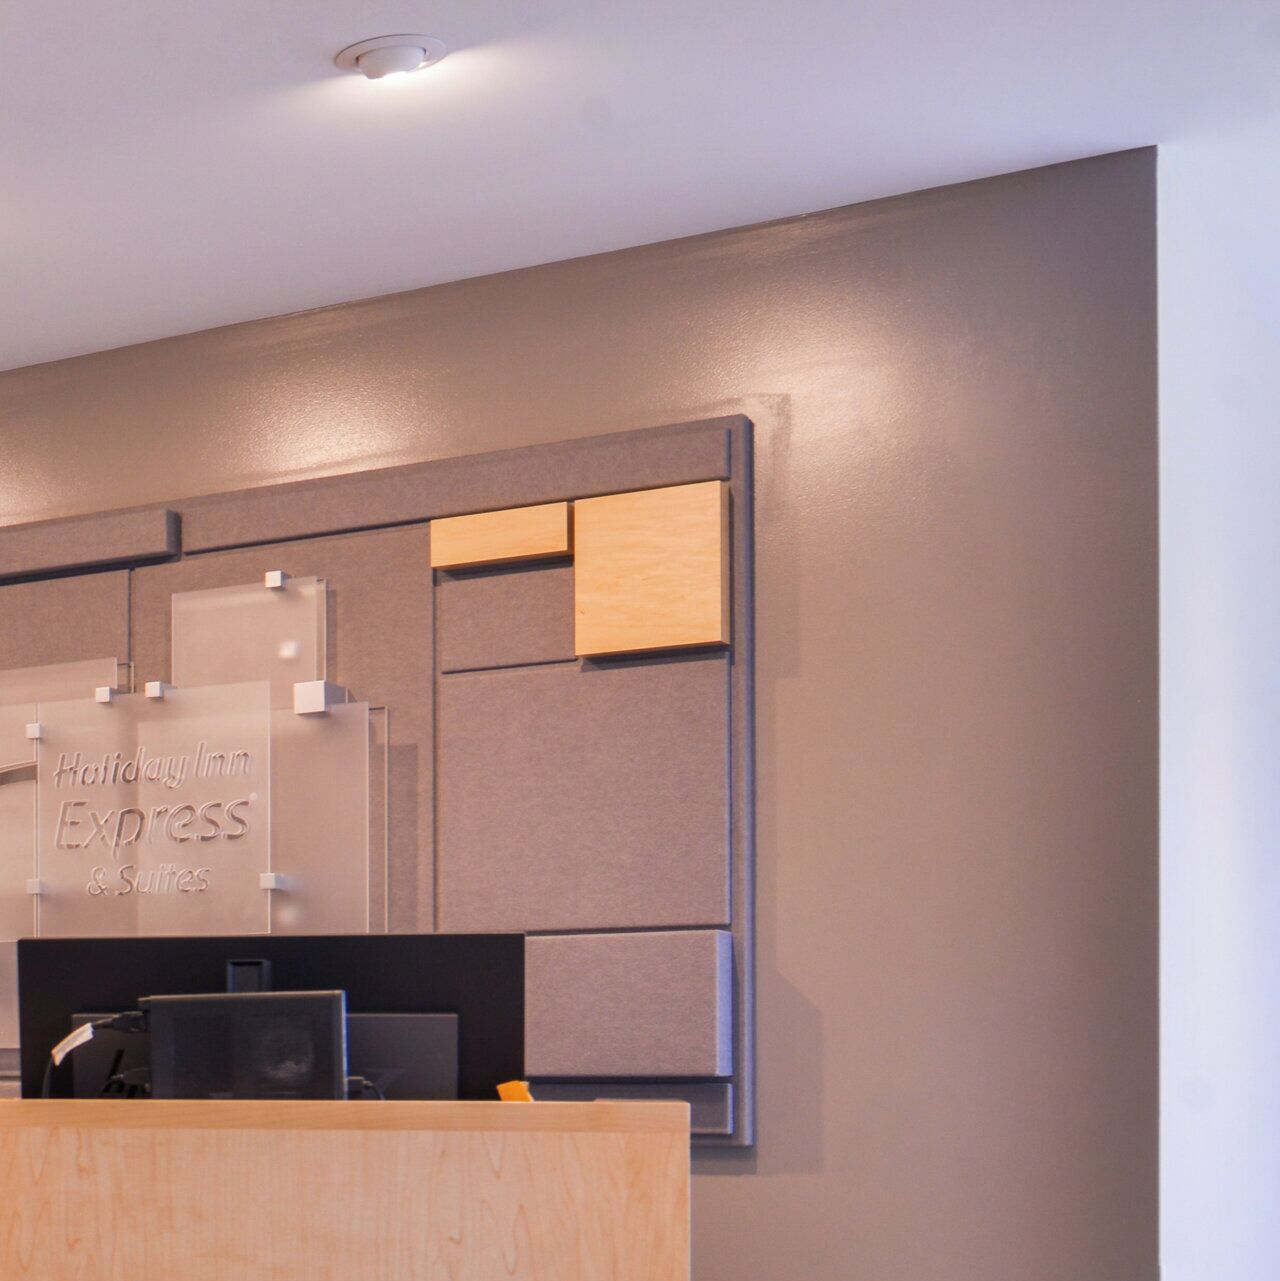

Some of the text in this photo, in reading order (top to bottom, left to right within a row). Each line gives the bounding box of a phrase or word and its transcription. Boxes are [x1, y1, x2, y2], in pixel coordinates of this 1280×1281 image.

[53, 741, 252, 790] Holiday Inn
[54, 799, 251, 860] Express
[86, 863, 211, 897] & Suites
